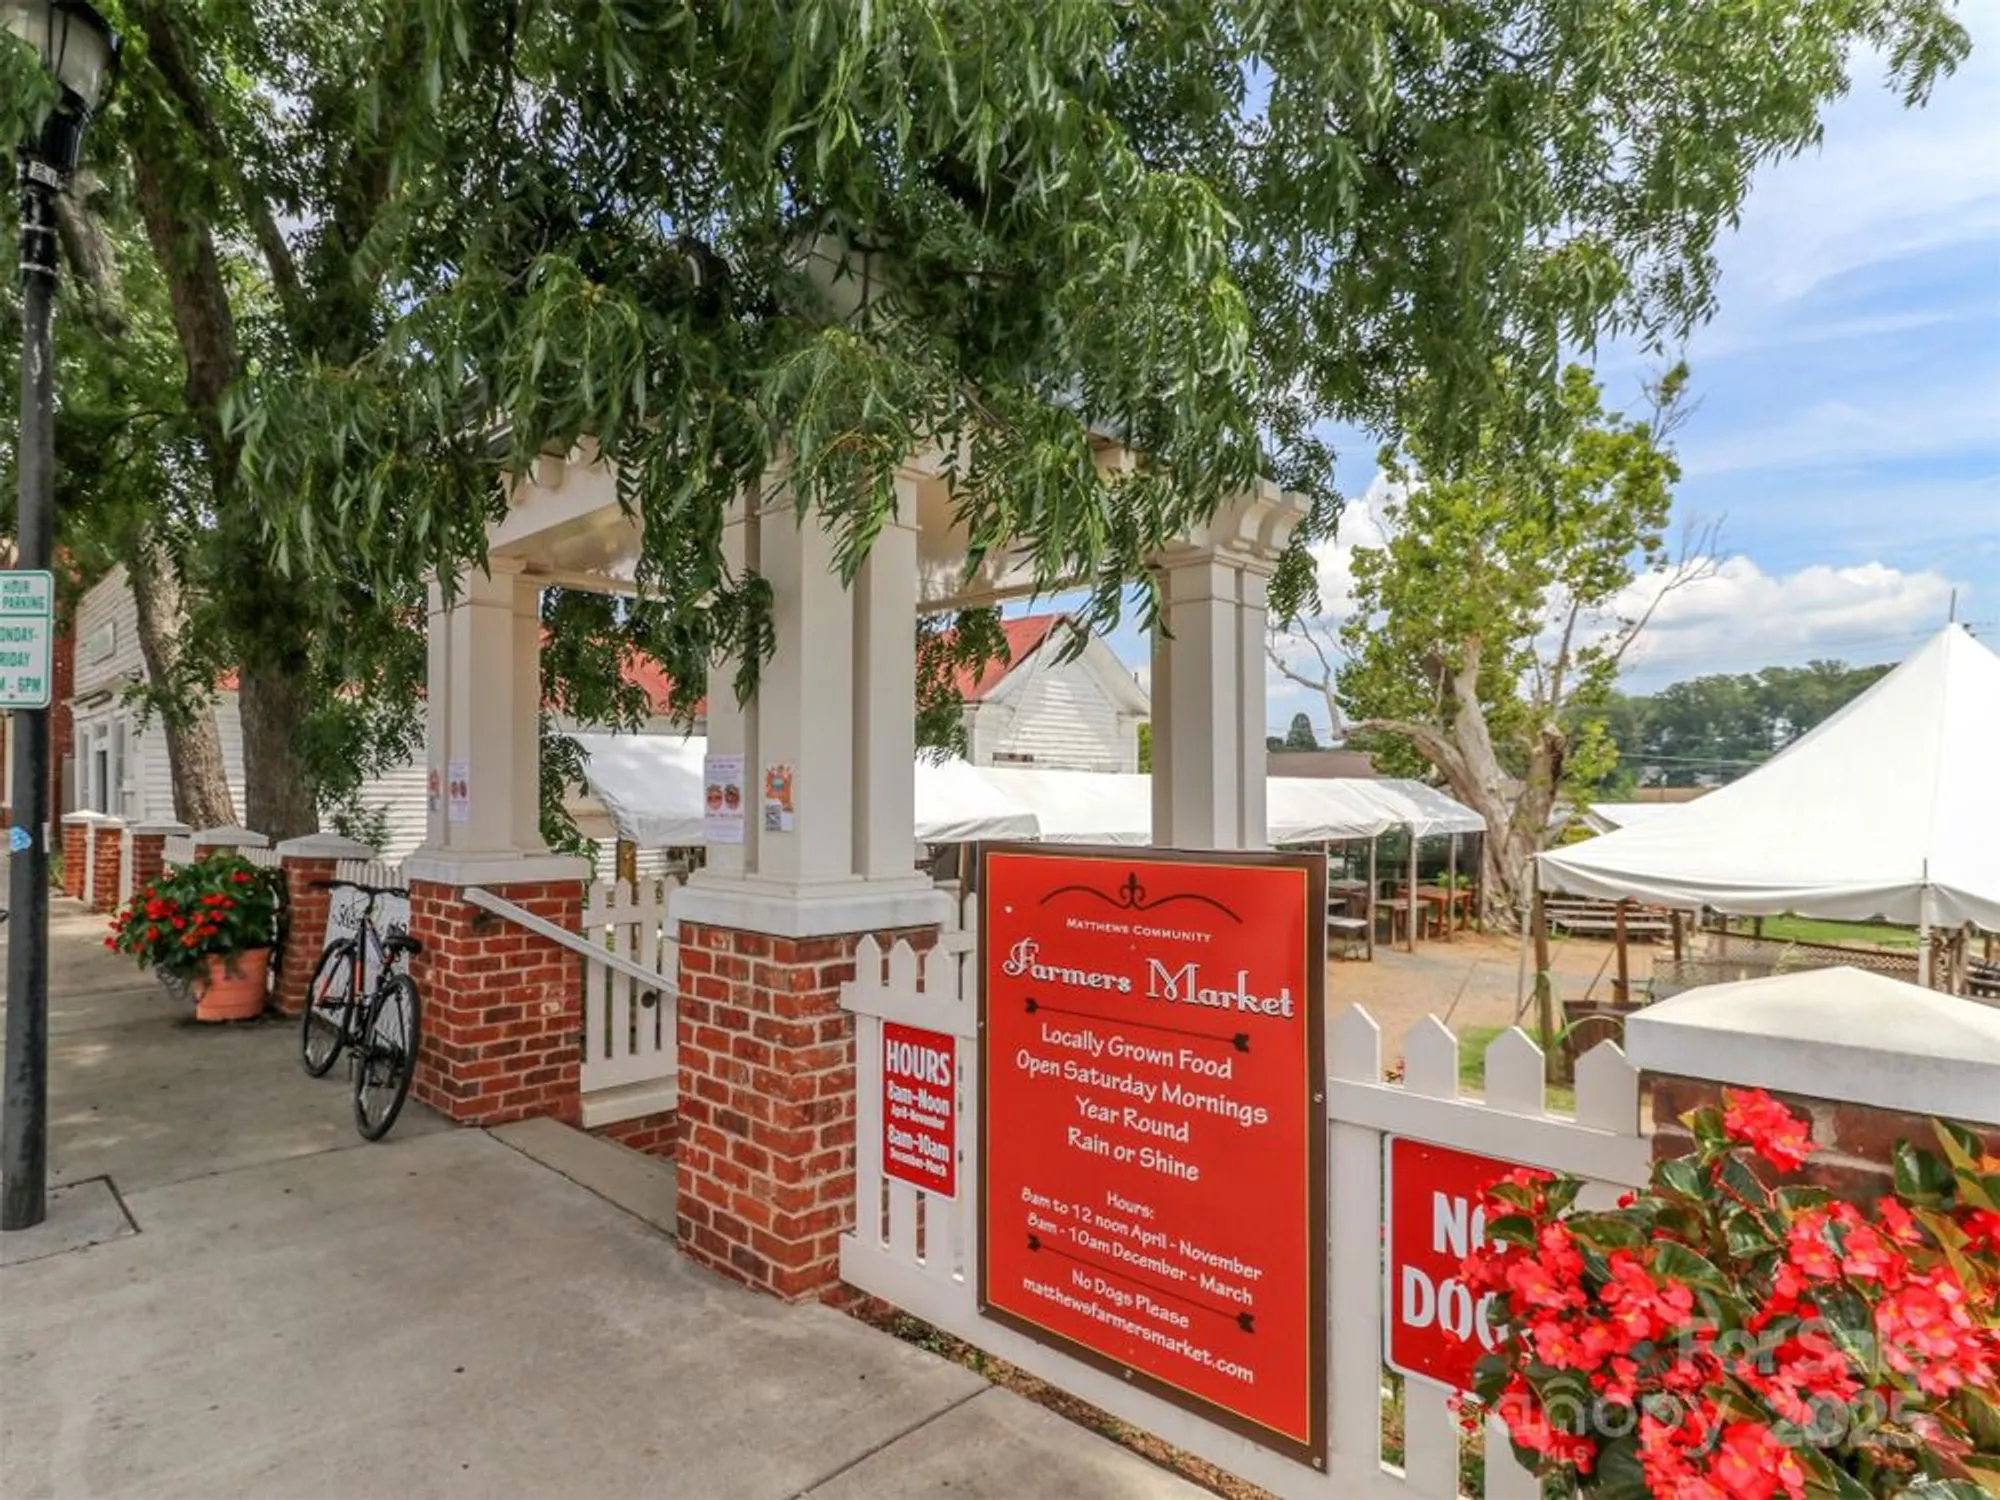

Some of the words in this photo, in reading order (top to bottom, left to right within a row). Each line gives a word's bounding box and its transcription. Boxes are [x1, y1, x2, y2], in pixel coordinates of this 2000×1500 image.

[2, 596, 44, 610] PARKING
[1002, 937, 1131, 993] Farmers
[1145, 957, 1294, 1019] Market
[886, 1038, 951, 1088] HOURS
[1042, 1022, 1105, 1057] Locally
[1108, 1035, 1173, 1067] Grown
[1179, 1049, 1232, 1079] Food
[1016, 1049, 1060, 1079] Open
[1064, 1060, 1157, 1104] Saturday
[1162, 1081, 1268, 1128] Mornings
[1075, 1095, 1119, 1123] Year
[1123, 1107, 1189, 1143] Round
[1067, 1126, 1109, 1156] Rain
[1113, 1145, 1135, 1163] or
[1139, 1147, 1199, 1181] Shine
[1021, 1186, 1050, 1209] 8am
[1053, 1199, 1069, 1215] to
[1072, 1203, 1092, 1223] 12
[1095, 1215, 1128, 1236] noon
[1130, 1224, 1167, 1249] April
[1179, 1240, 1263, 1281] November
[1106, 1190, 1154, 1219] Hours:
[1027, 1212, 1057, 1235] 8am
[1069, 1227, 1110, 1254] 10am
[1113, 1242, 1187, 1281] December
[1199, 1273, 1253, 1306] March
[1072, 1268, 1092, 1290] No
[1094, 1278, 1133, 1307] Dogs
[1136, 1293, 1189, 1329] Please
[1402, 1265, 1533, 1362] DOG
[1023, 1276, 1254, 1385] matthewsfarmersmarket.com
